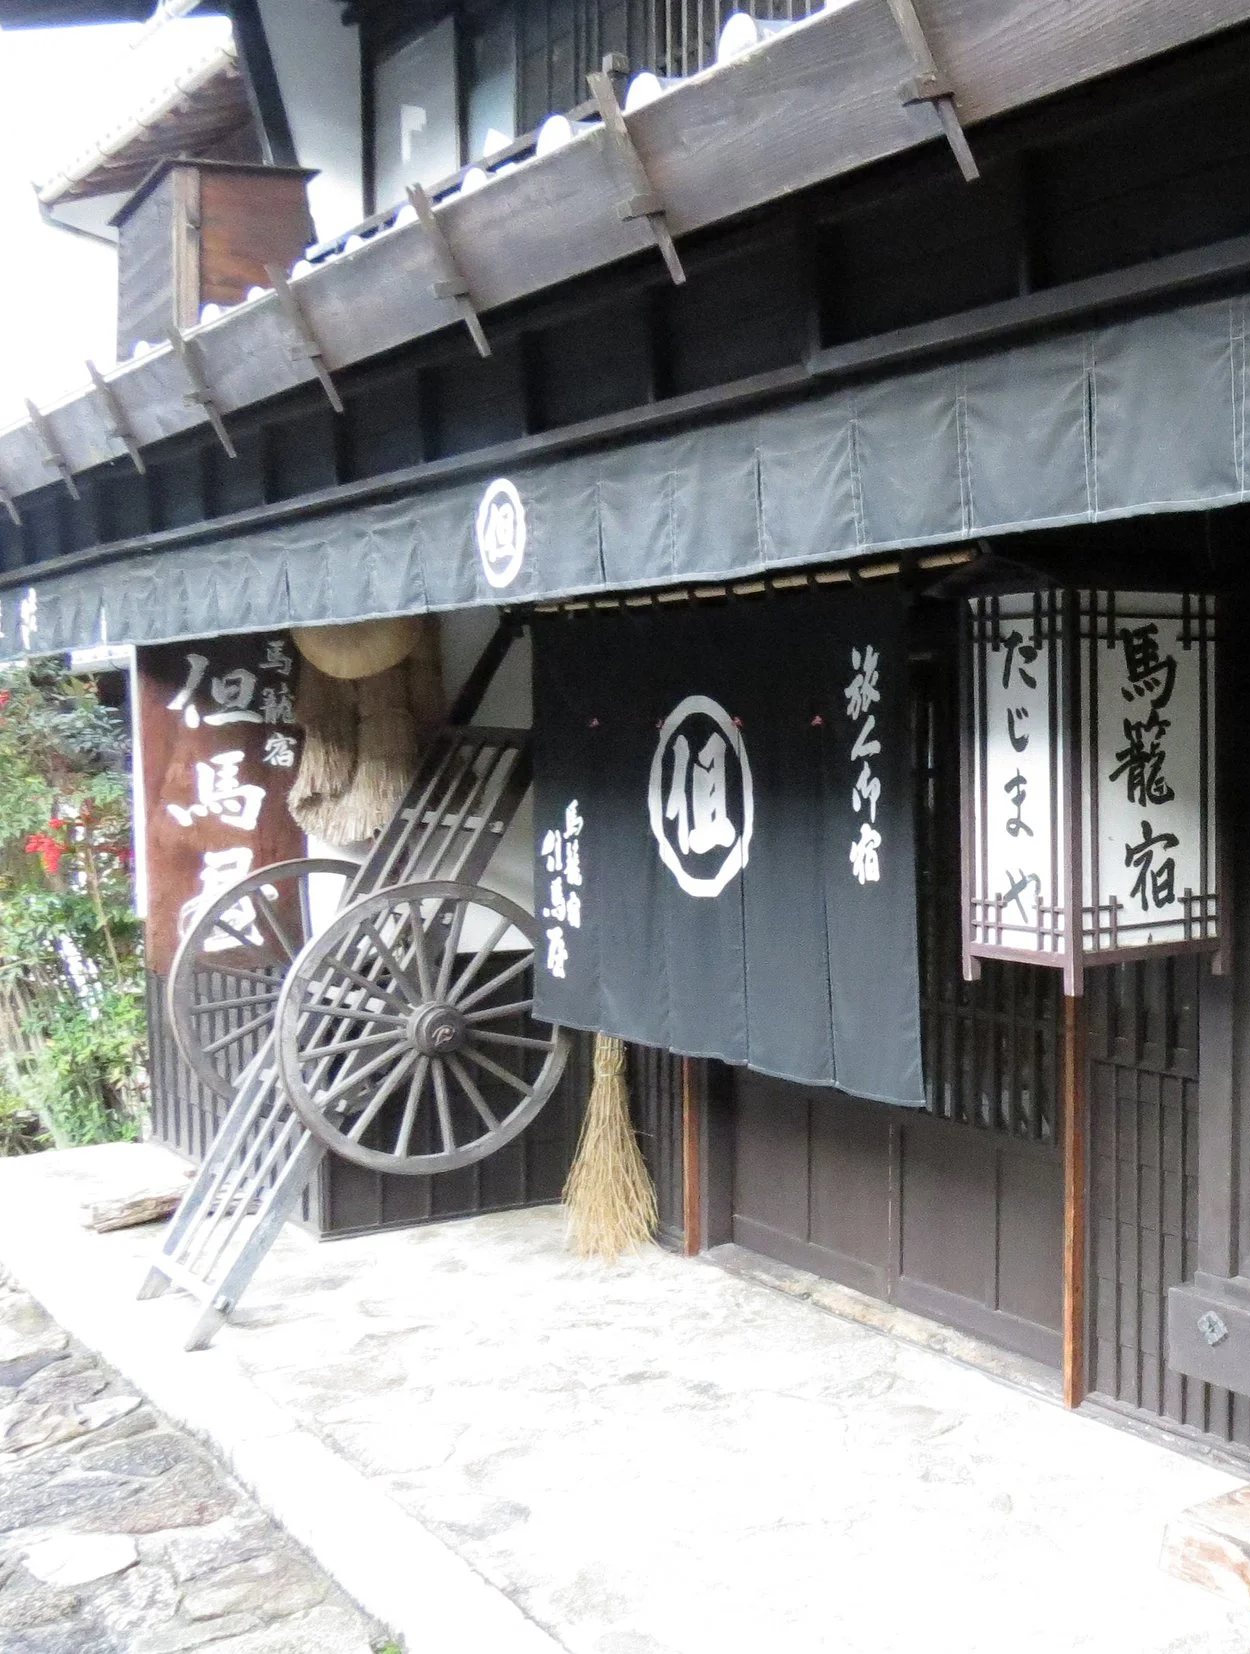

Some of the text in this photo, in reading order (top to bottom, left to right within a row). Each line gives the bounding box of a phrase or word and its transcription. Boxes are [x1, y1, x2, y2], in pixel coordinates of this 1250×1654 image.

[1001, 629, 1041, 924] たじまや
[1109, 622, 1179, 911] 馬籠宿
